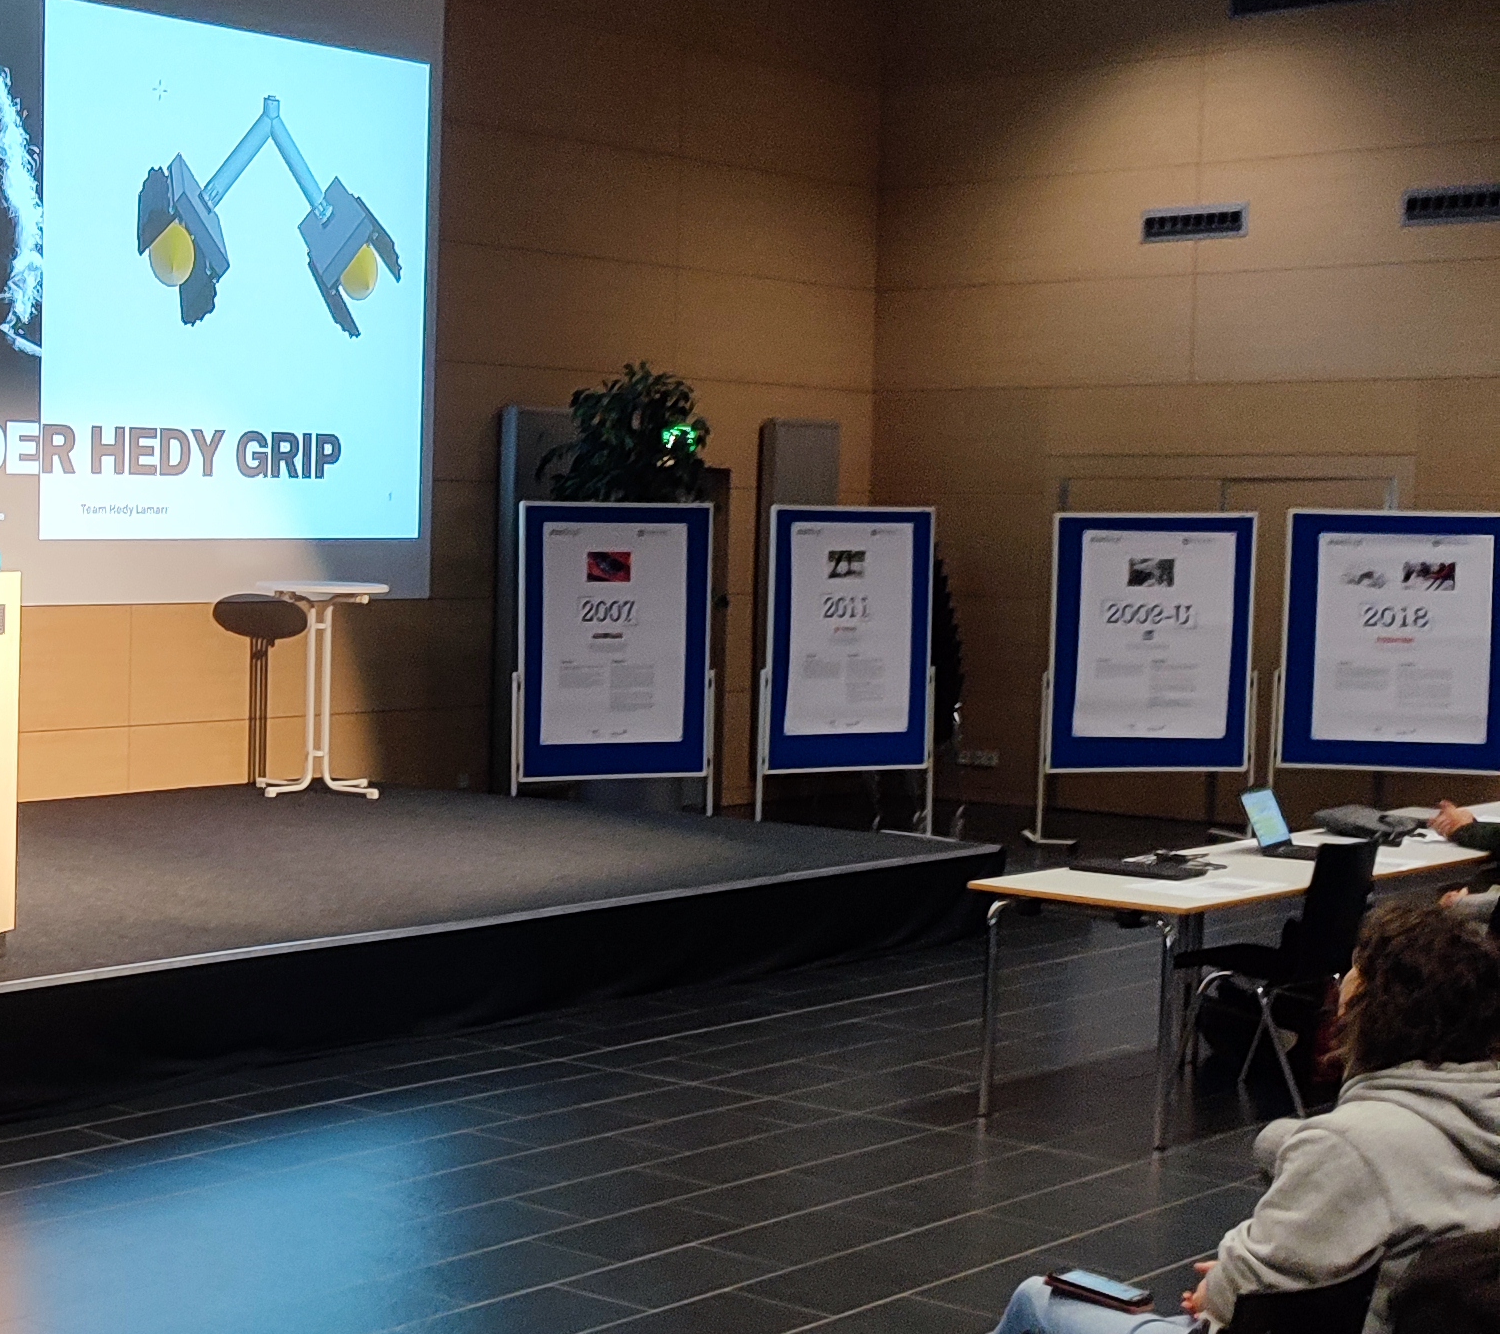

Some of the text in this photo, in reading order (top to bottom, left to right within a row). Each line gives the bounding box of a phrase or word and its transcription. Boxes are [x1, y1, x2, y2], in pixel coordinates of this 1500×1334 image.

[90, 425, 226, 477] HEDY
[236, 430, 342, 479] GRIP
[80, 503, 170, 517] Team Hedy Lamarr
[581, 599, 636, 623] 2007
[1362, 606, 1429, 628] 2018
